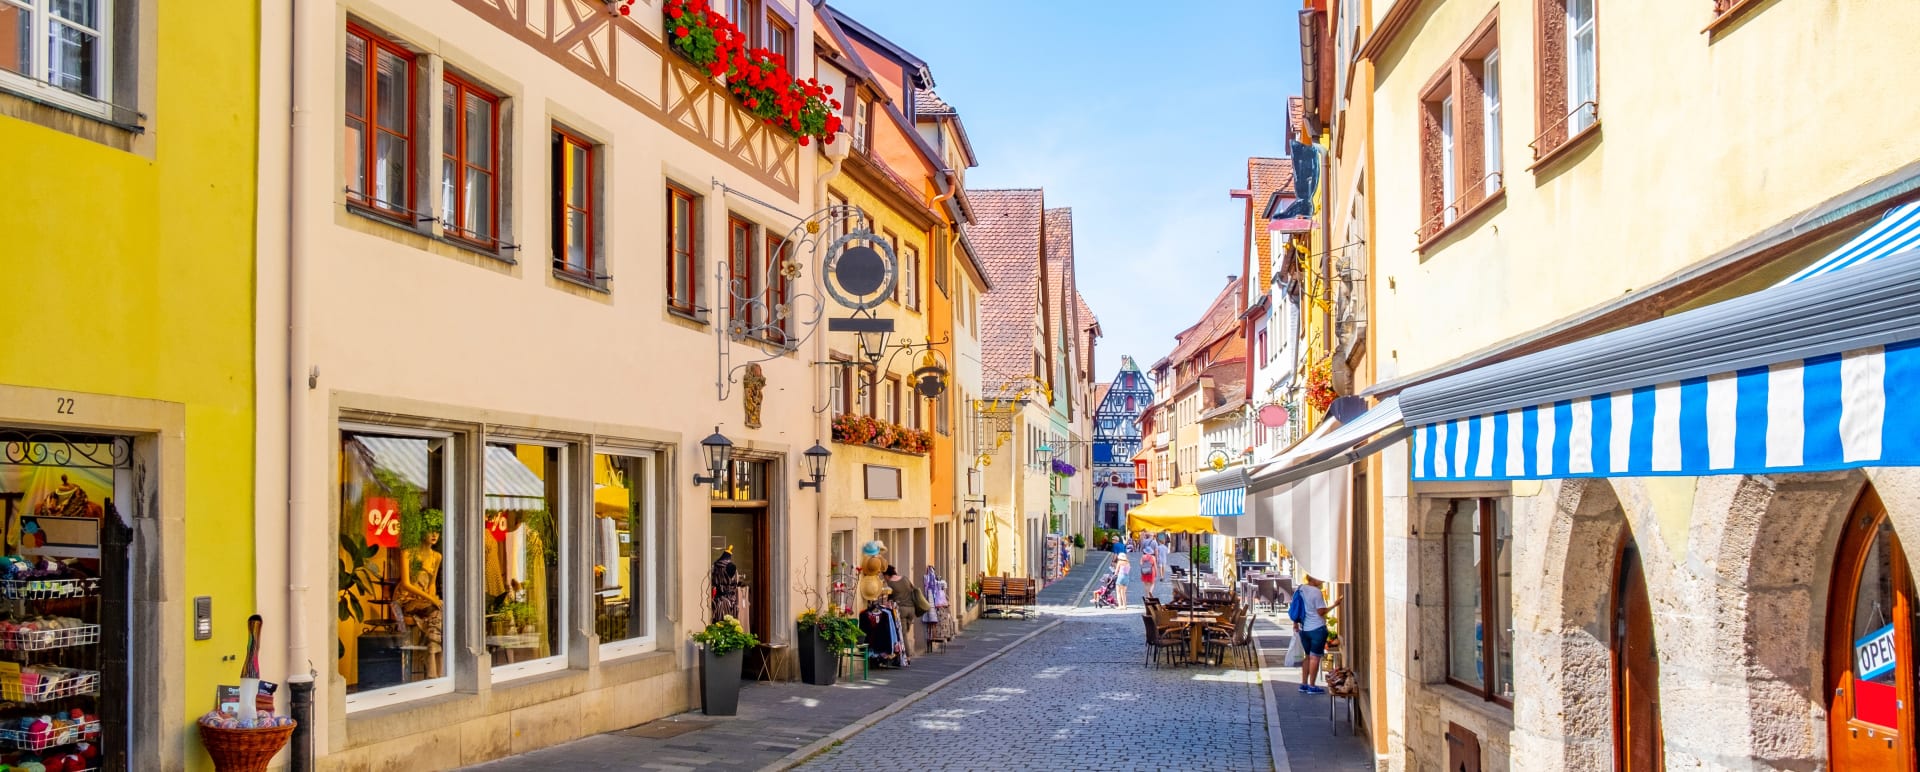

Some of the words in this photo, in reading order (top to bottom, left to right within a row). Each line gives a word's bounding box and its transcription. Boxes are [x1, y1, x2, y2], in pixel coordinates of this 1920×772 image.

[57, 397, 74, 415] 22
[368, 509, 400, 536] %
[1861, 632, 1895, 671] OPEN
